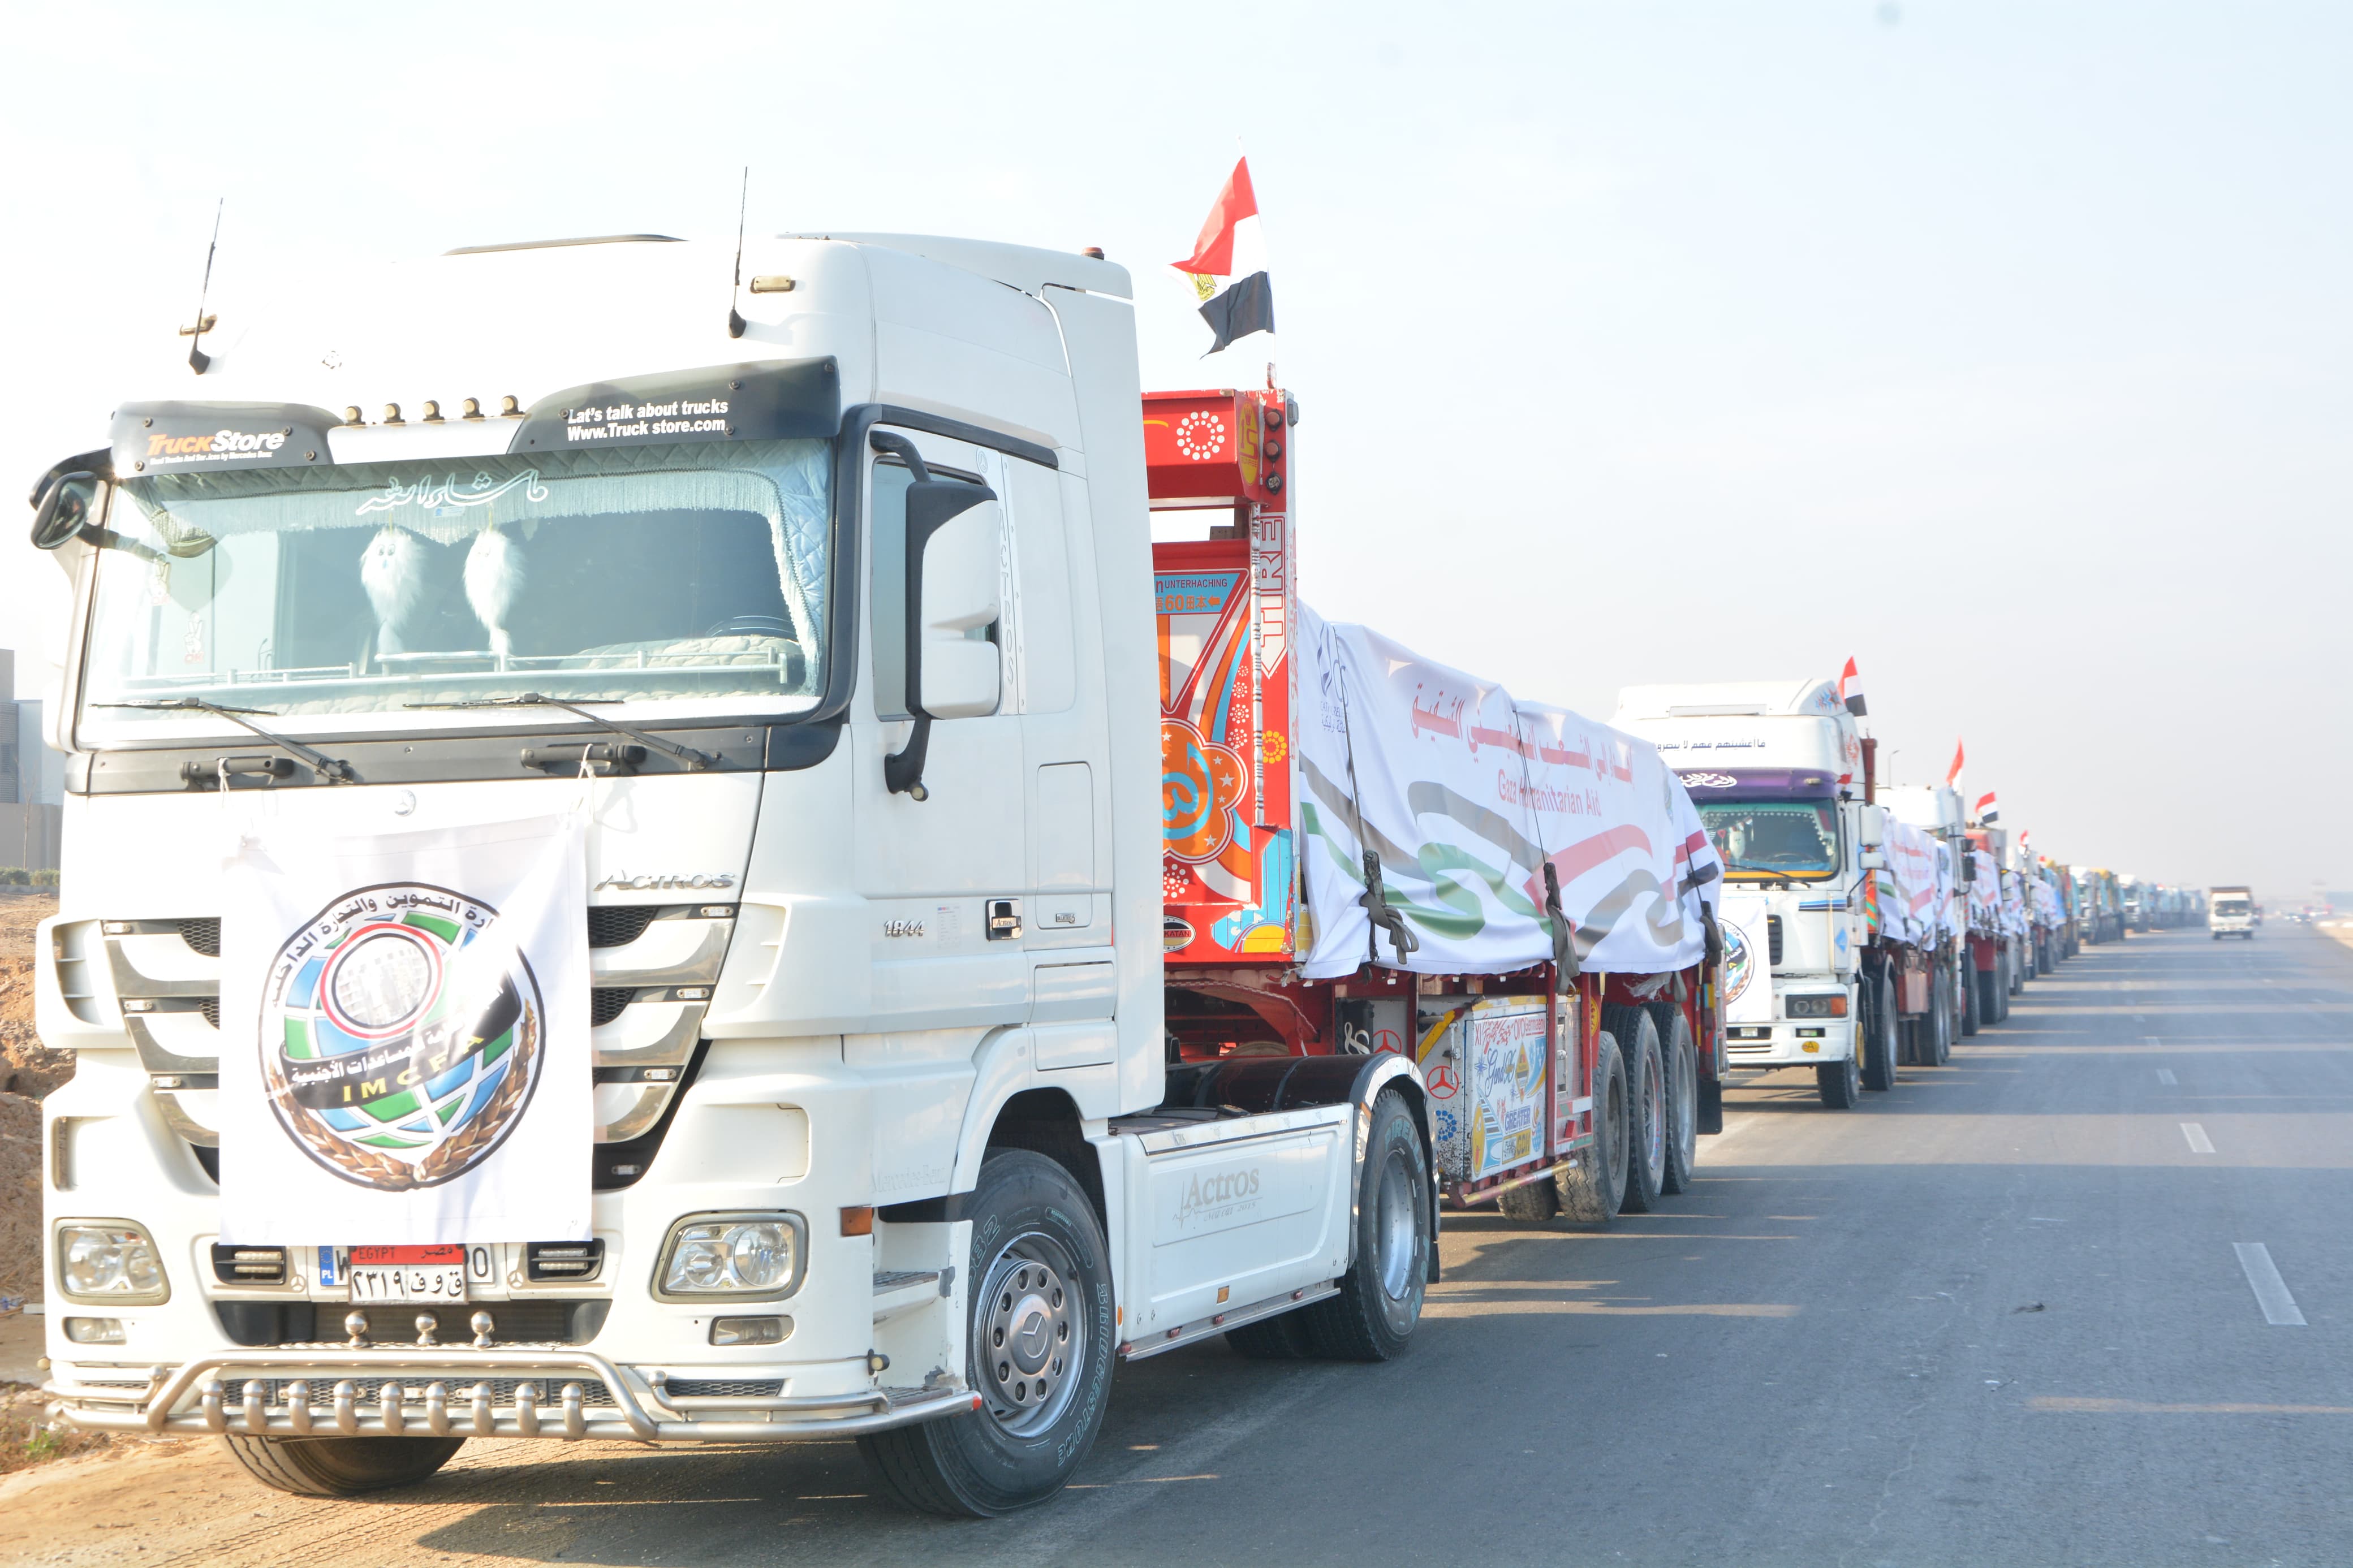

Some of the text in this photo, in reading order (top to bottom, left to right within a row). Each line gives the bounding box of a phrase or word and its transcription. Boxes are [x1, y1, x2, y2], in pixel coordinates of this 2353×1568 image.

[567, 398, 729, 424] Lat's talk about trucks
[567, 418, 726, 441] Www.Truck store.com
[1165, 578, 1228, 589] UNTERHACHING
[1657, 742, 1680, 753] يبصرو
[1498, 768, 1602, 817] Gaza Humanitarian Aid
[386, 892, 461, 914] التموين
[318, 897, 378, 935] والتجارة
[465, 905, 494, 930] ارة
[884, 918, 925, 938] 1844
[1384, 1117, 1425, 1173] PIRELLI
[1183, 1168, 1260, 1210] Actros
[358, 1246, 395, 1260] EGYPT
[420, 1246, 453, 1259] مصر
[321, 1269, 333, 1280] PL
[1057, 1282, 1109, 1468] BRIDGESTONE
